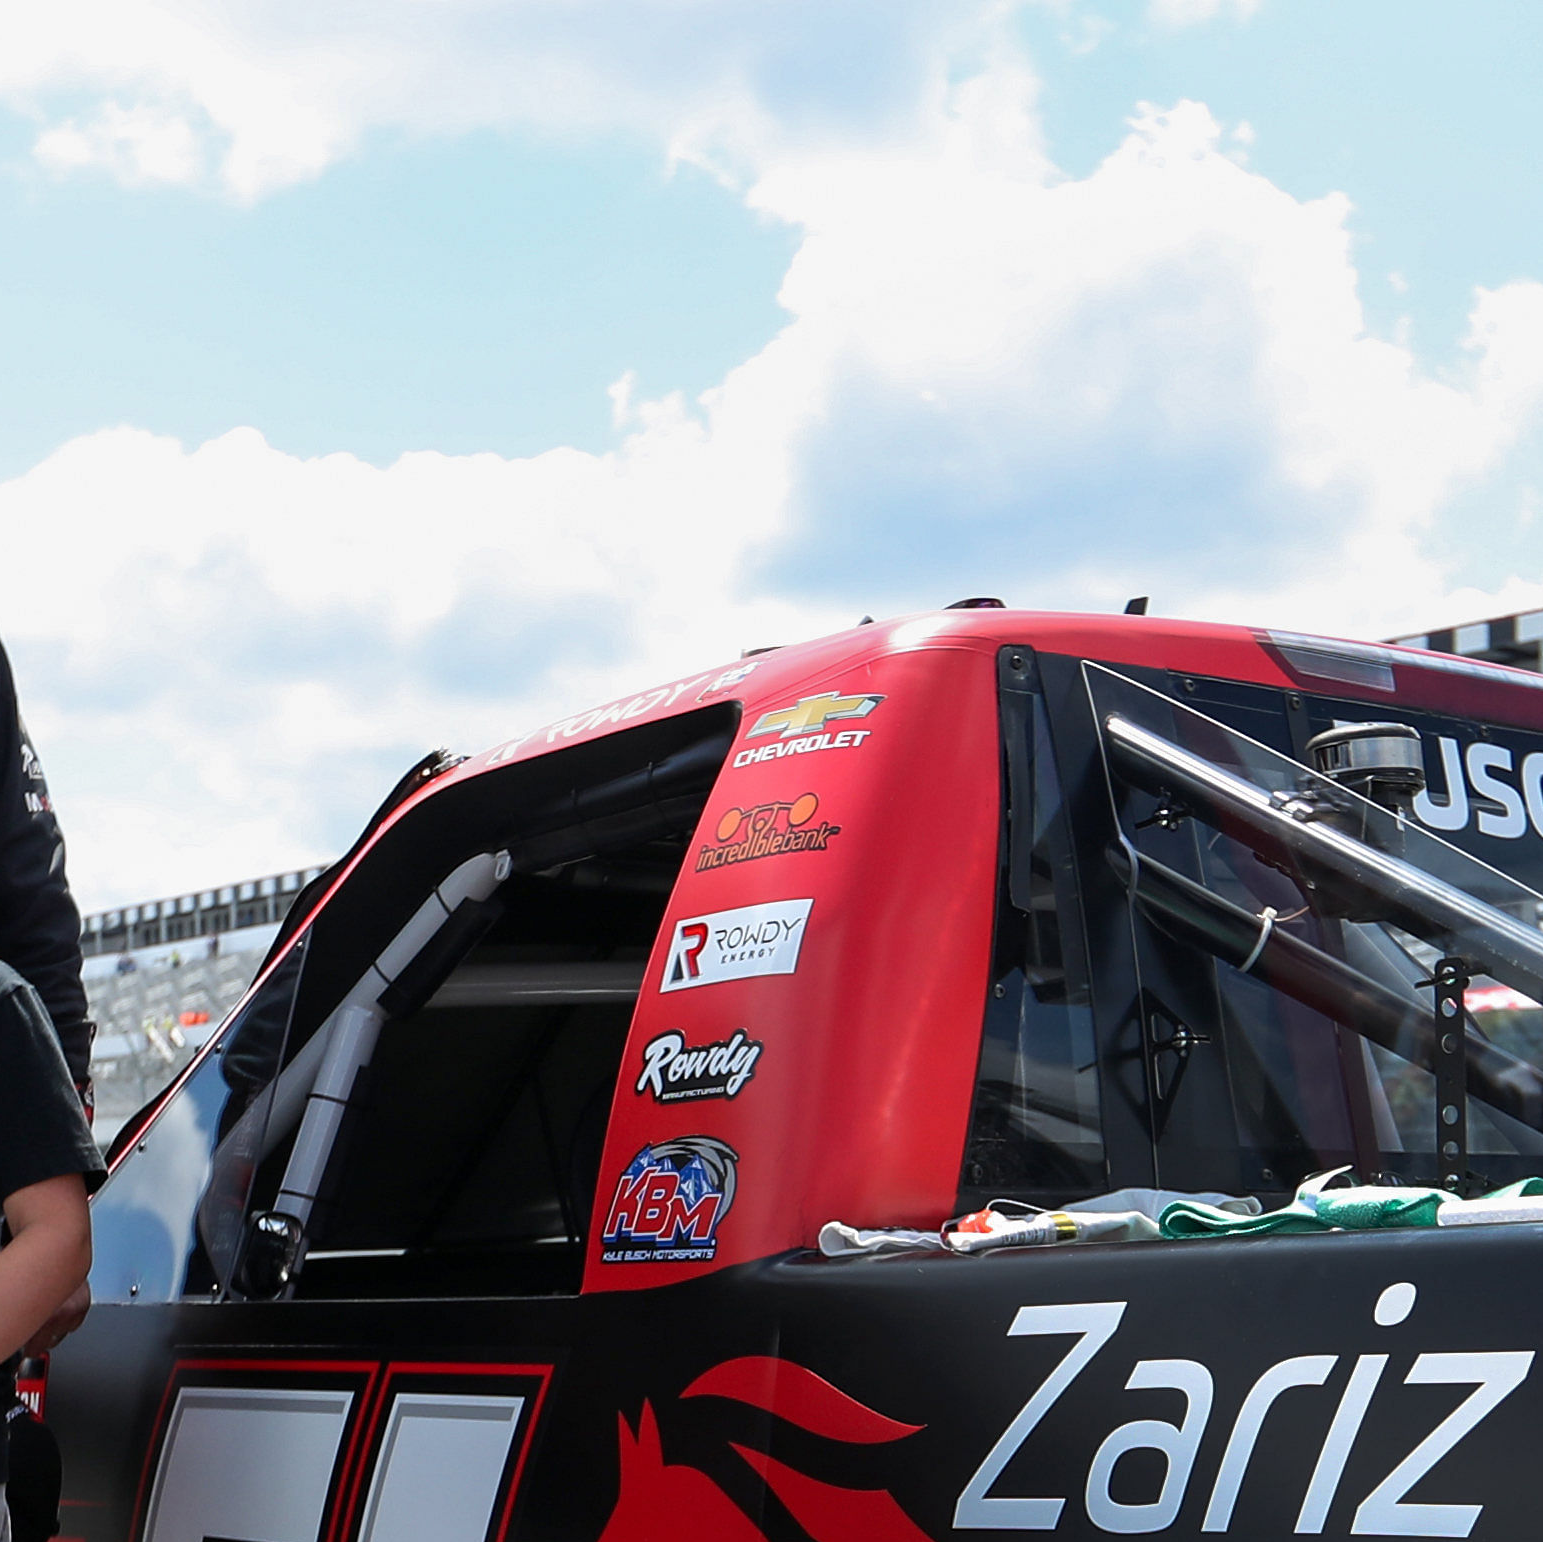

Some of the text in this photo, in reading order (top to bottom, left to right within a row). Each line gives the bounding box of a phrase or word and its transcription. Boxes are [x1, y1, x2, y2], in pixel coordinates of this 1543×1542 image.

[733, 731, 870, 768] CHEVROLET
[714, 918, 803, 952] ROWDY
[720, 947, 776, 965] ENERGY
[636, 1034, 760, 1097] Rowdy
[603, 1167, 722, 1247] KBM
[602, 1249, 715, 1262] KYLE BUSCH MOTORSPORTS
[952, 1282, 1535, 1538] Zariz
